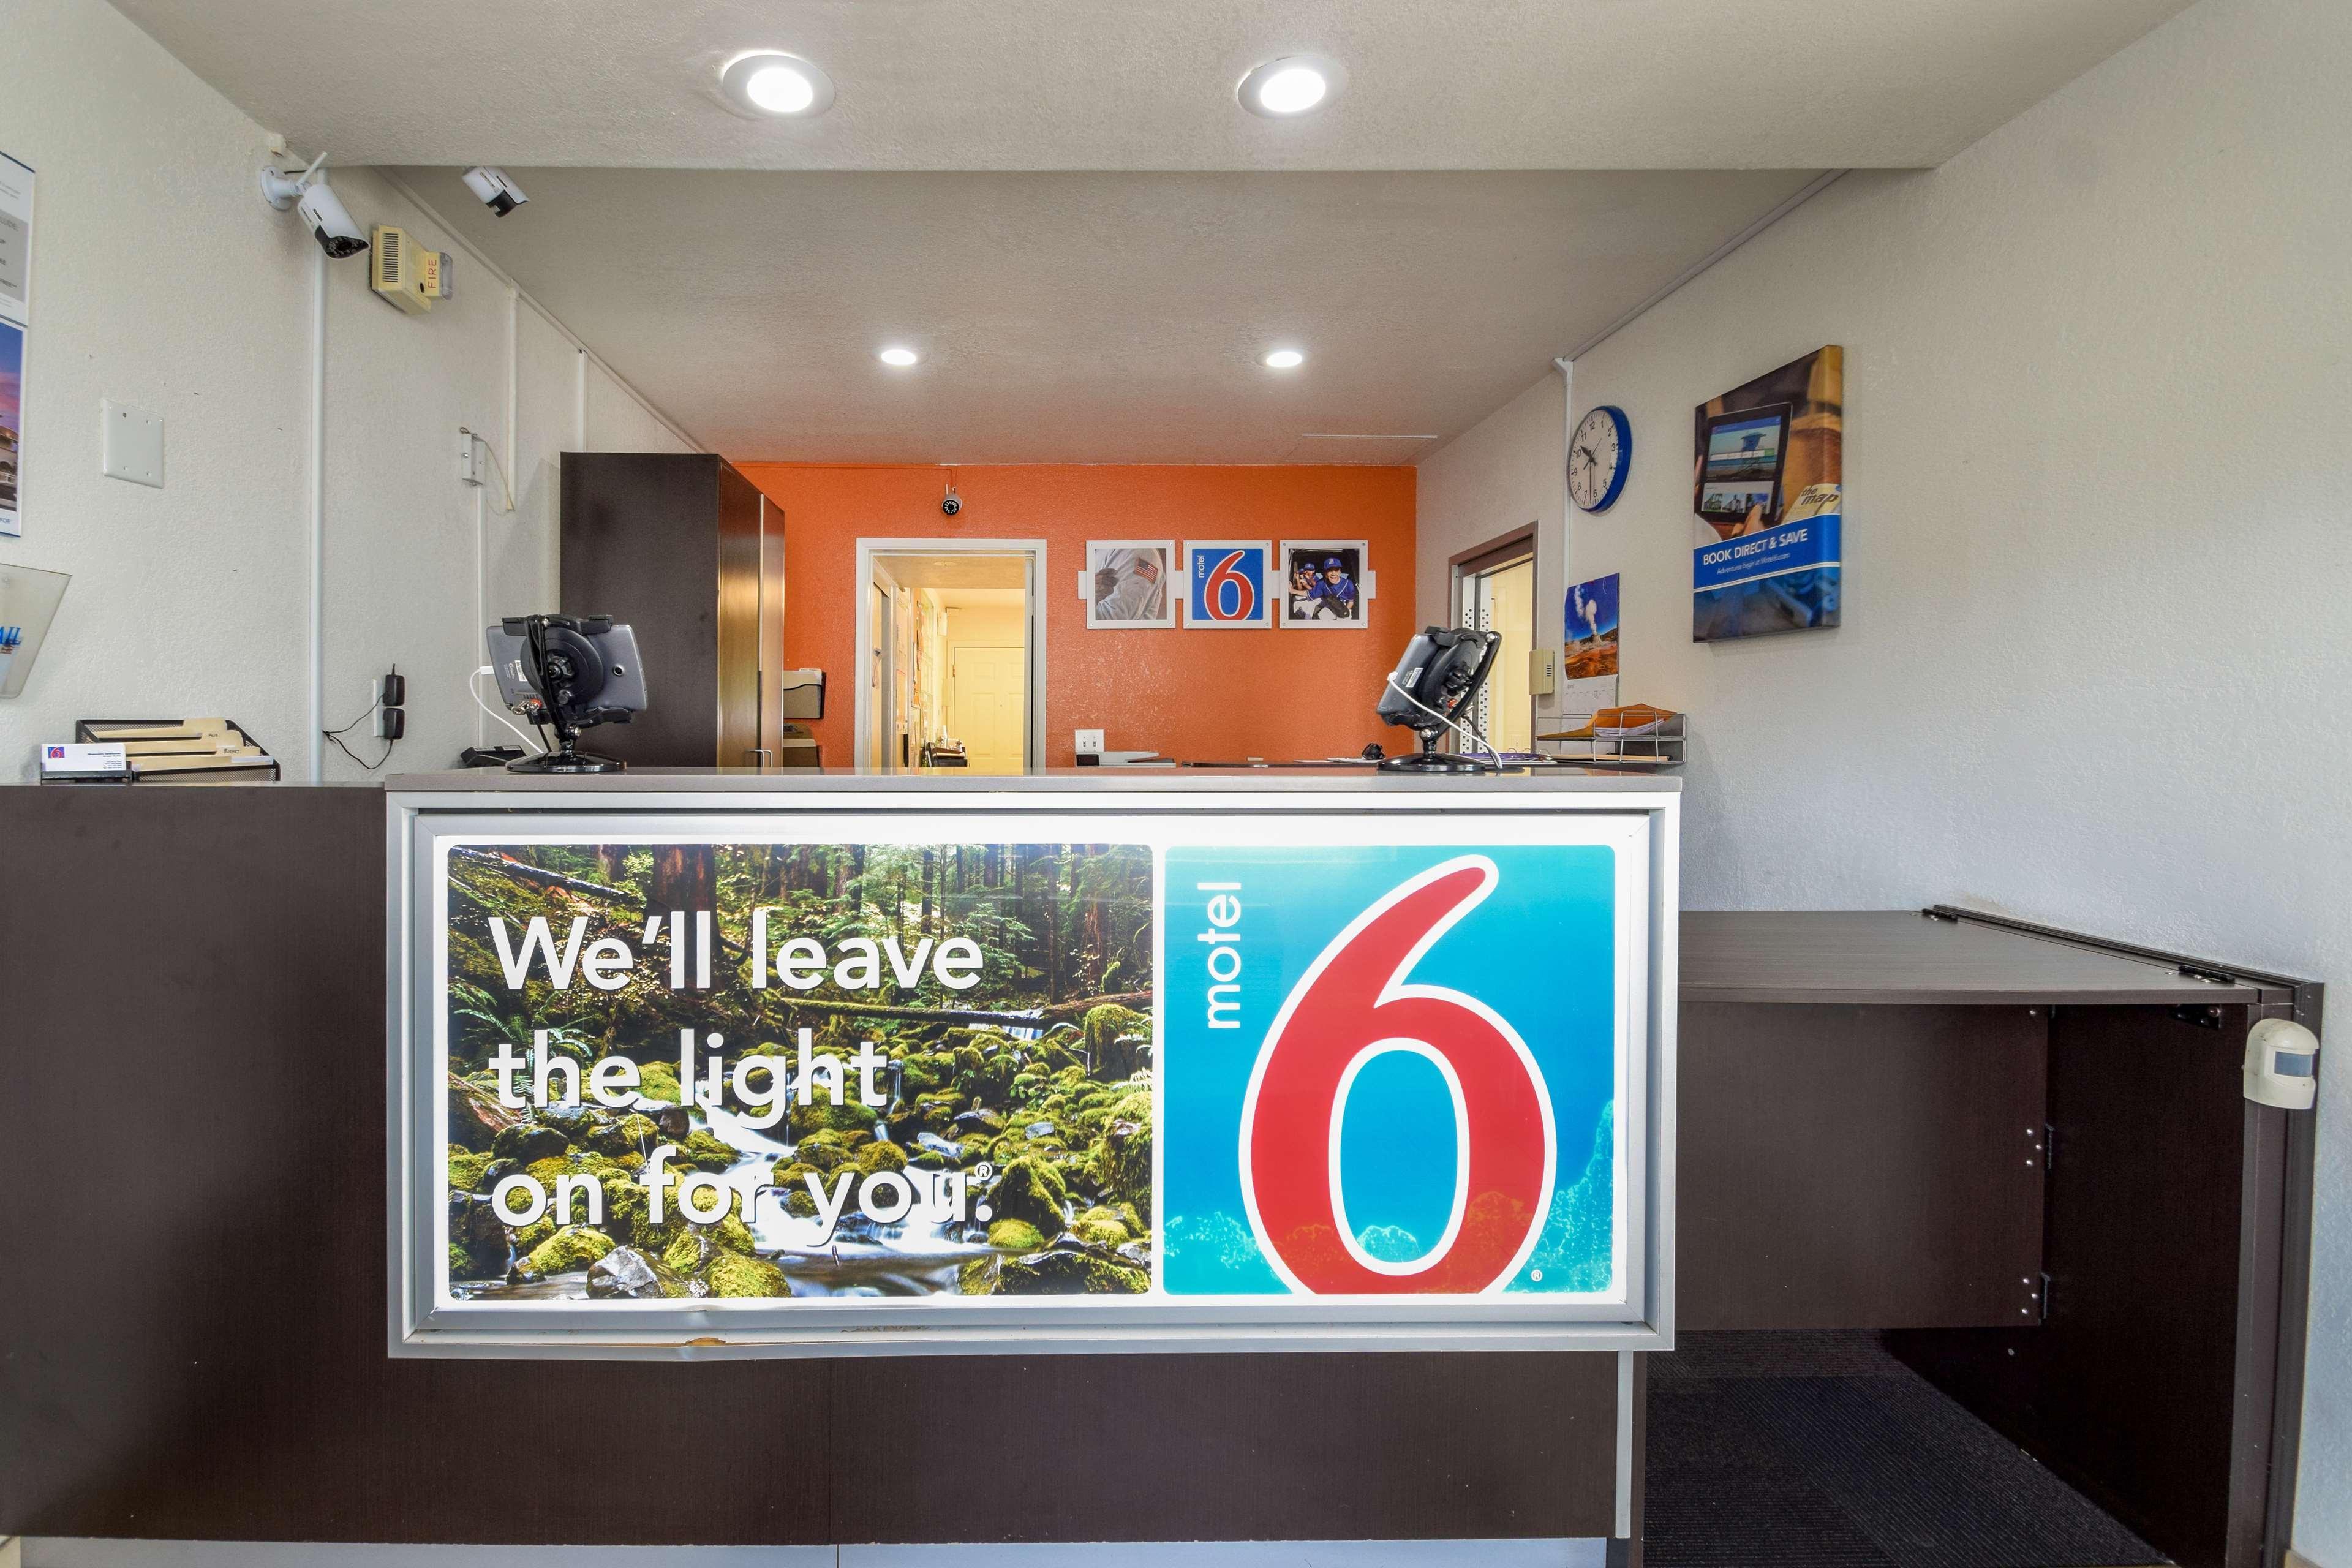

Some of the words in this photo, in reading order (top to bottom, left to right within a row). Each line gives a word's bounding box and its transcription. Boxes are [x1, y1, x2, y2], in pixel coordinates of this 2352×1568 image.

[428, 259, 437, 289] FIRE
[1589, 421, 1595, 431] 12
[1581, 432, 1587, 442] 11
[1608, 428, 1612, 437] 2
[1611, 443, 1615, 452] 3
[1574, 467, 1578, 476] 9
[1577, 482, 1581, 491] 8
[1603, 479, 1607, 488] 5
[1584, 490, 1588, 499] 7
[1593, 489, 1597, 498] 6
[1801, 486, 1819, 496] the
[1801, 494, 1839, 514] map
[1703, 548, 1732, 565] BOOK
[1734, 538, 1769, 559] DIRECT
[1768, 537, 1777, 549] &
[1779, 529, 1809, 547] SAVE
[1204, 549, 1255, 620] 6
[488, 911, 711, 990] We’ll
[752, 911, 984, 990] leave
[489, 1028, 641, 1108] the
[680, 1028, 888, 1130] light
[1197, 882, 1242, 1029] motel
[1238, 854, 1558, 1295] 6
[491, 1172, 603, 1226] on
[639, 1145, 774, 1225] for
